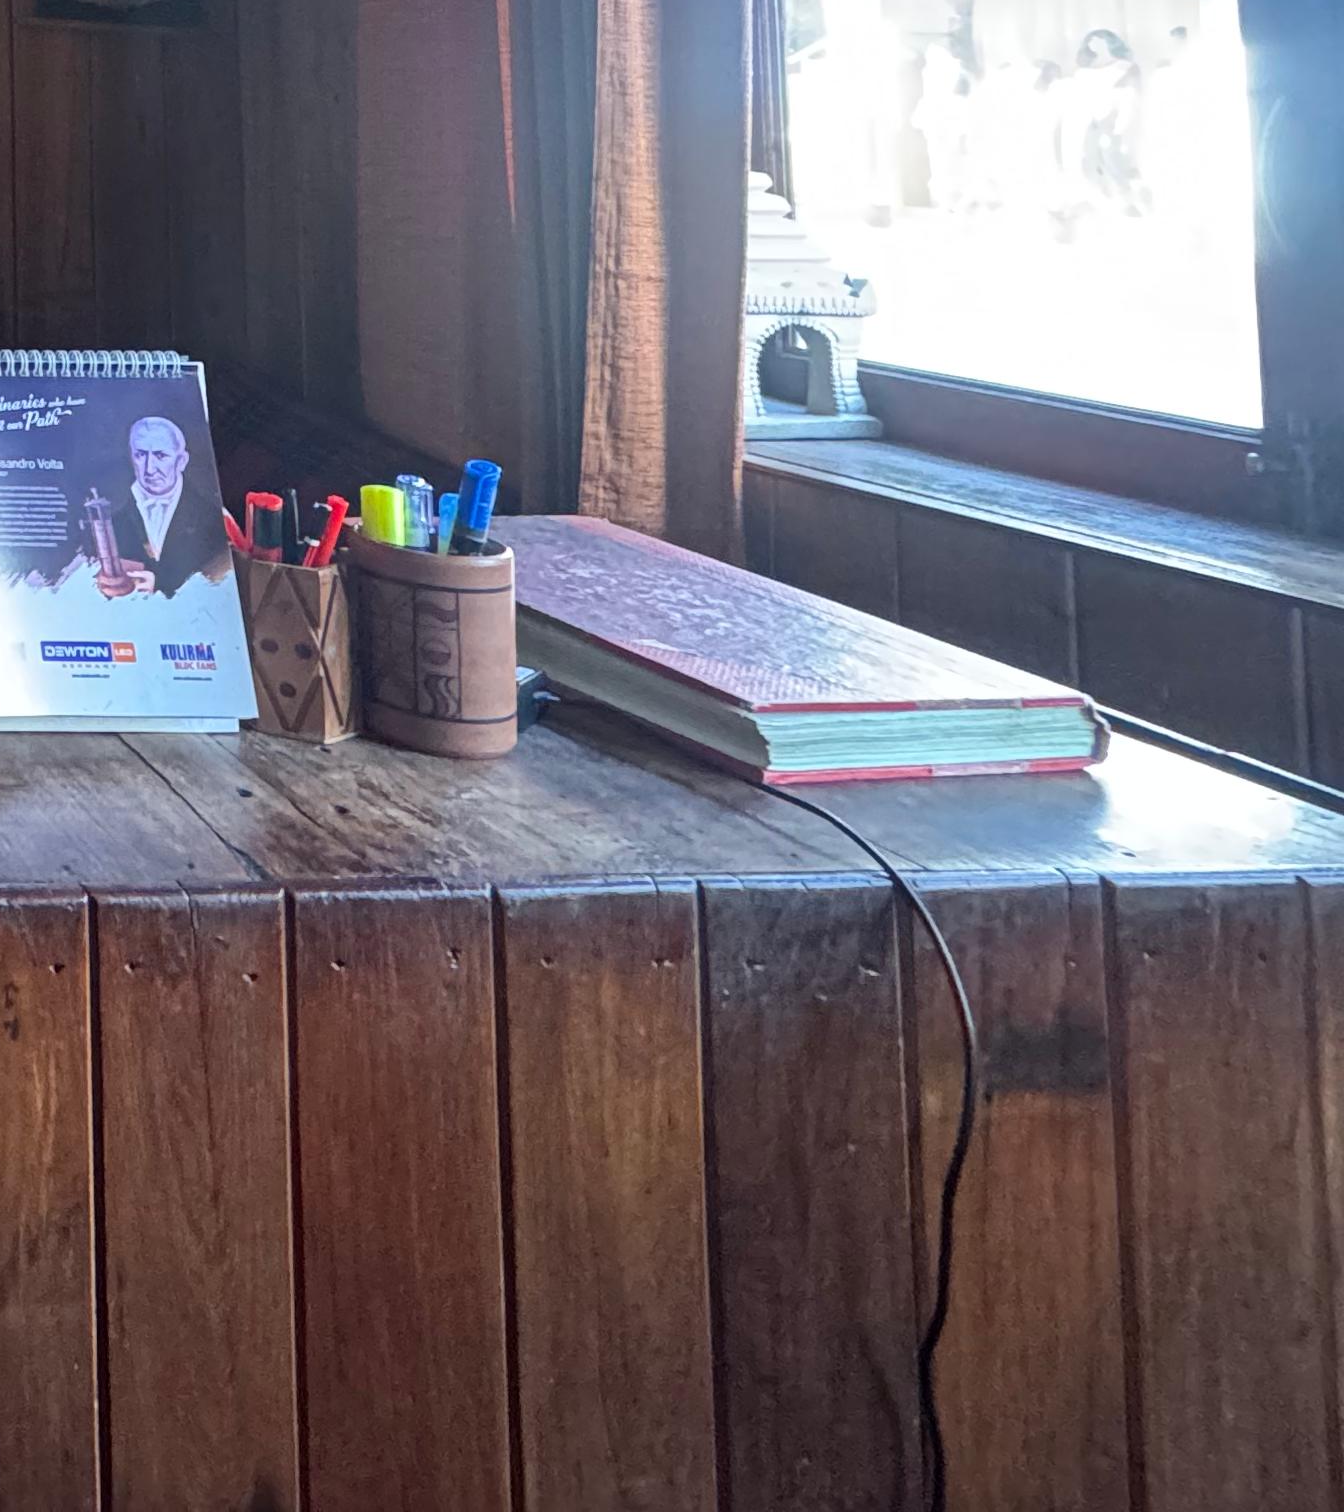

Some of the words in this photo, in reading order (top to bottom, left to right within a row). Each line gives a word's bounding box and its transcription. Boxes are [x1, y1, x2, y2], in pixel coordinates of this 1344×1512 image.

[22, 407, 72, 431] Path
[36, 457, 64, 470] Volta
[44, 645, 109, 658] DEWTON
